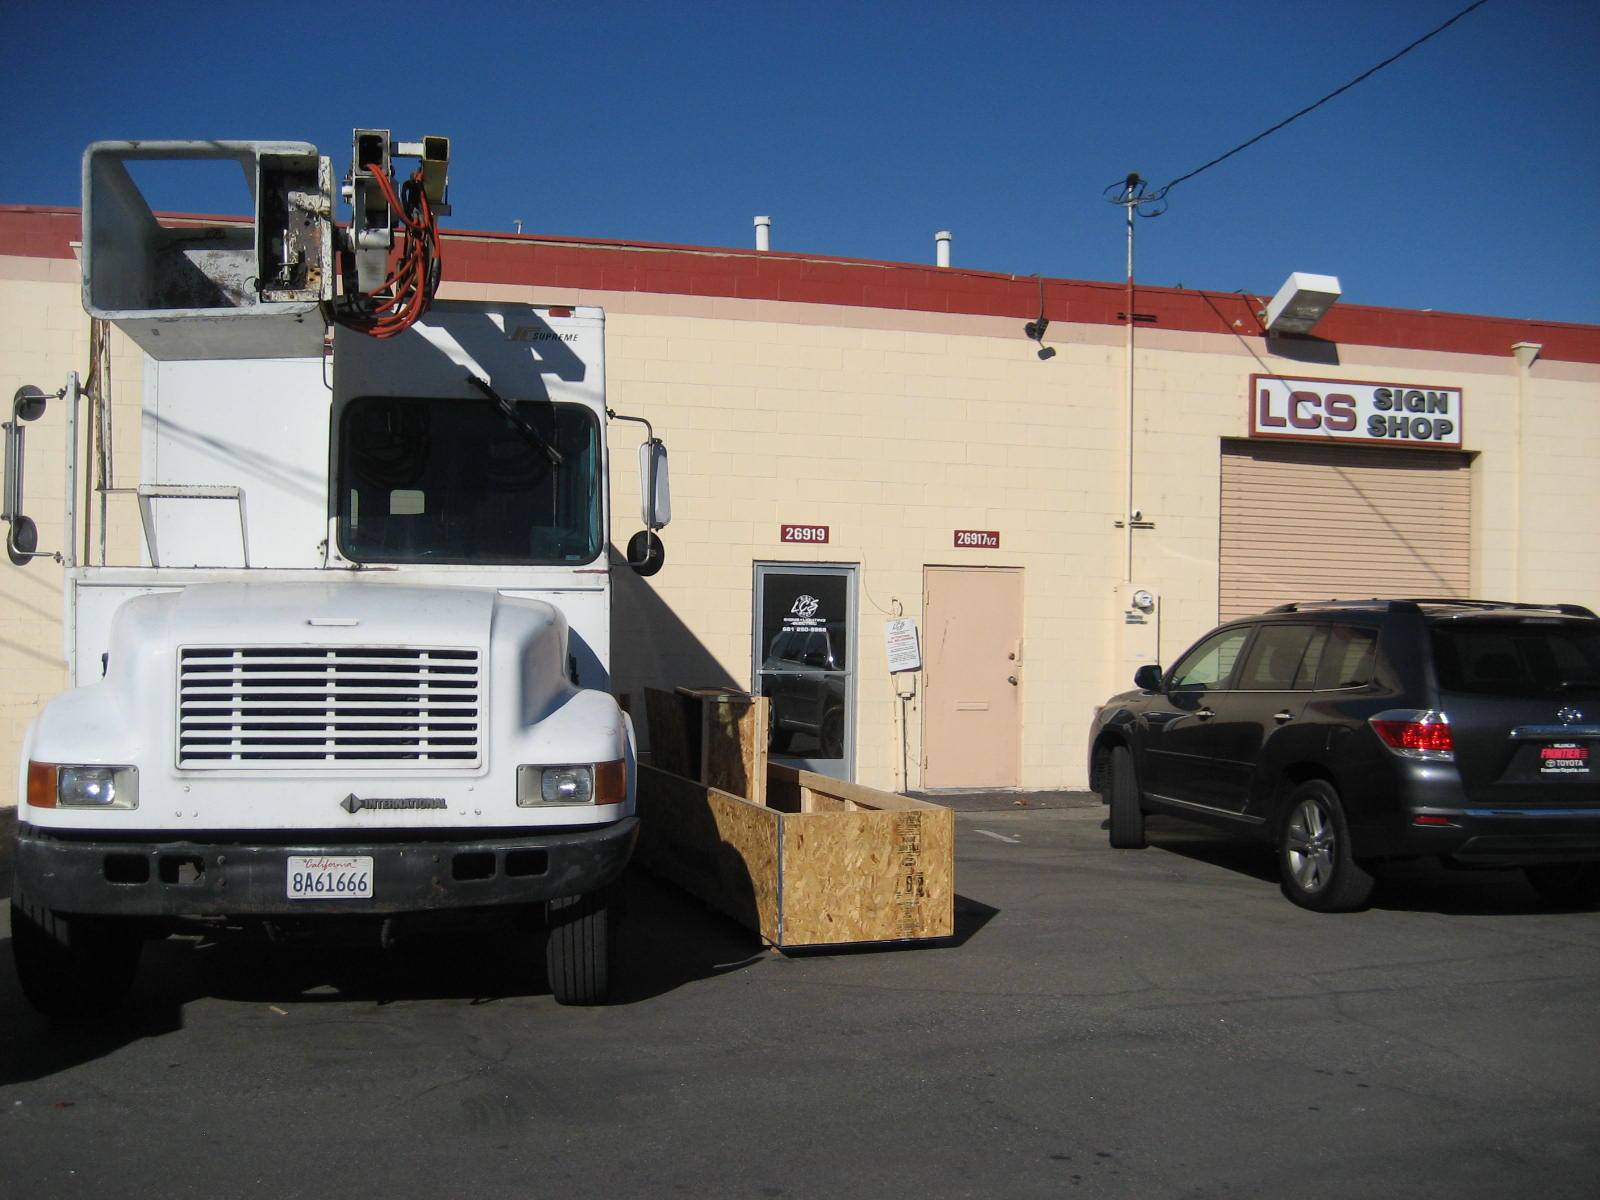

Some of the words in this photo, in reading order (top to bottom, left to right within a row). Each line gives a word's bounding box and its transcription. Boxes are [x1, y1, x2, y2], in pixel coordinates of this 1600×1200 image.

[532, 332, 579, 342] SUPREME
[1373, 387, 1449, 415] SIGN
[1259, 388, 1358, 432] LCS
[1366, 413, 1454, 441] SHOP
[785, 527, 826, 541] 26919
[790, 598, 820, 614] LCS
[1556, 759, 1585, 767] TOYOTA
[362, 798, 448, 810] INTERNATIONAL
[304, 858, 355, 871] California
[292, 871, 368, 893] 8A61666
